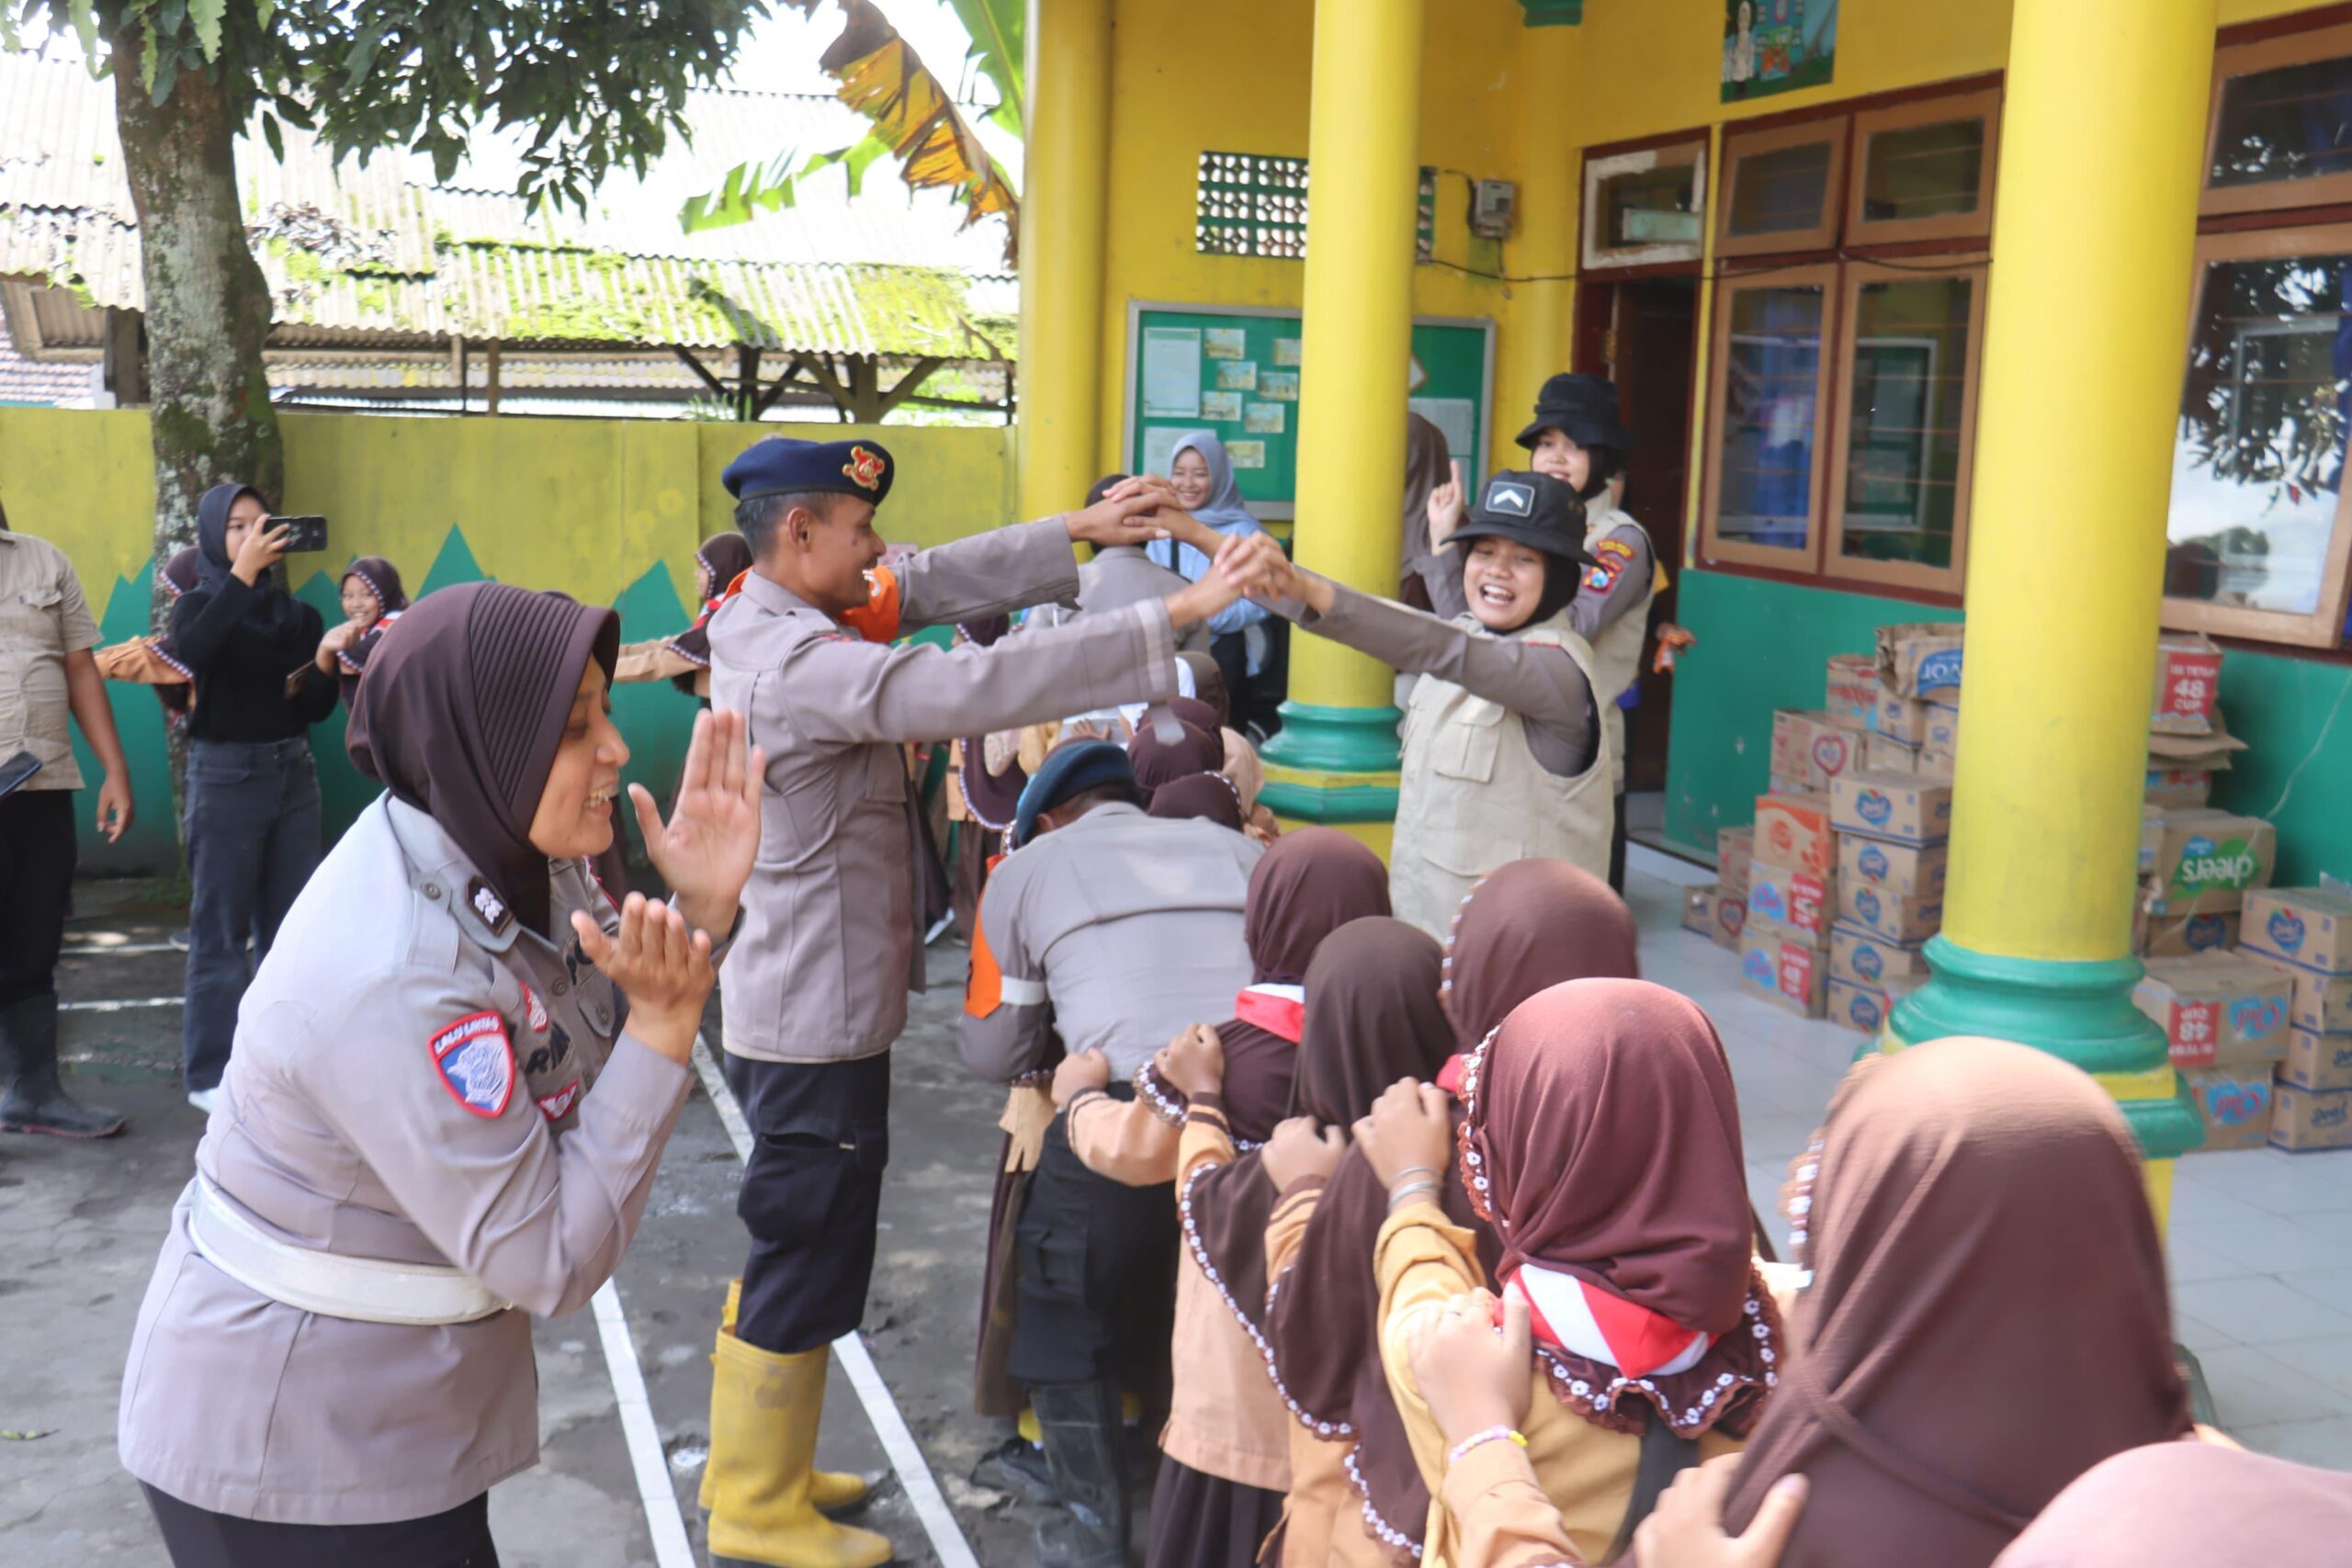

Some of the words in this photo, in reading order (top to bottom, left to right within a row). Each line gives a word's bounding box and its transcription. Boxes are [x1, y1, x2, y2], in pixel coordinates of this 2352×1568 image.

[2174, 679, 2205, 698] 48
[2182, 855, 2253, 888] cheers
[2179, 1021, 2210, 1042] 48
